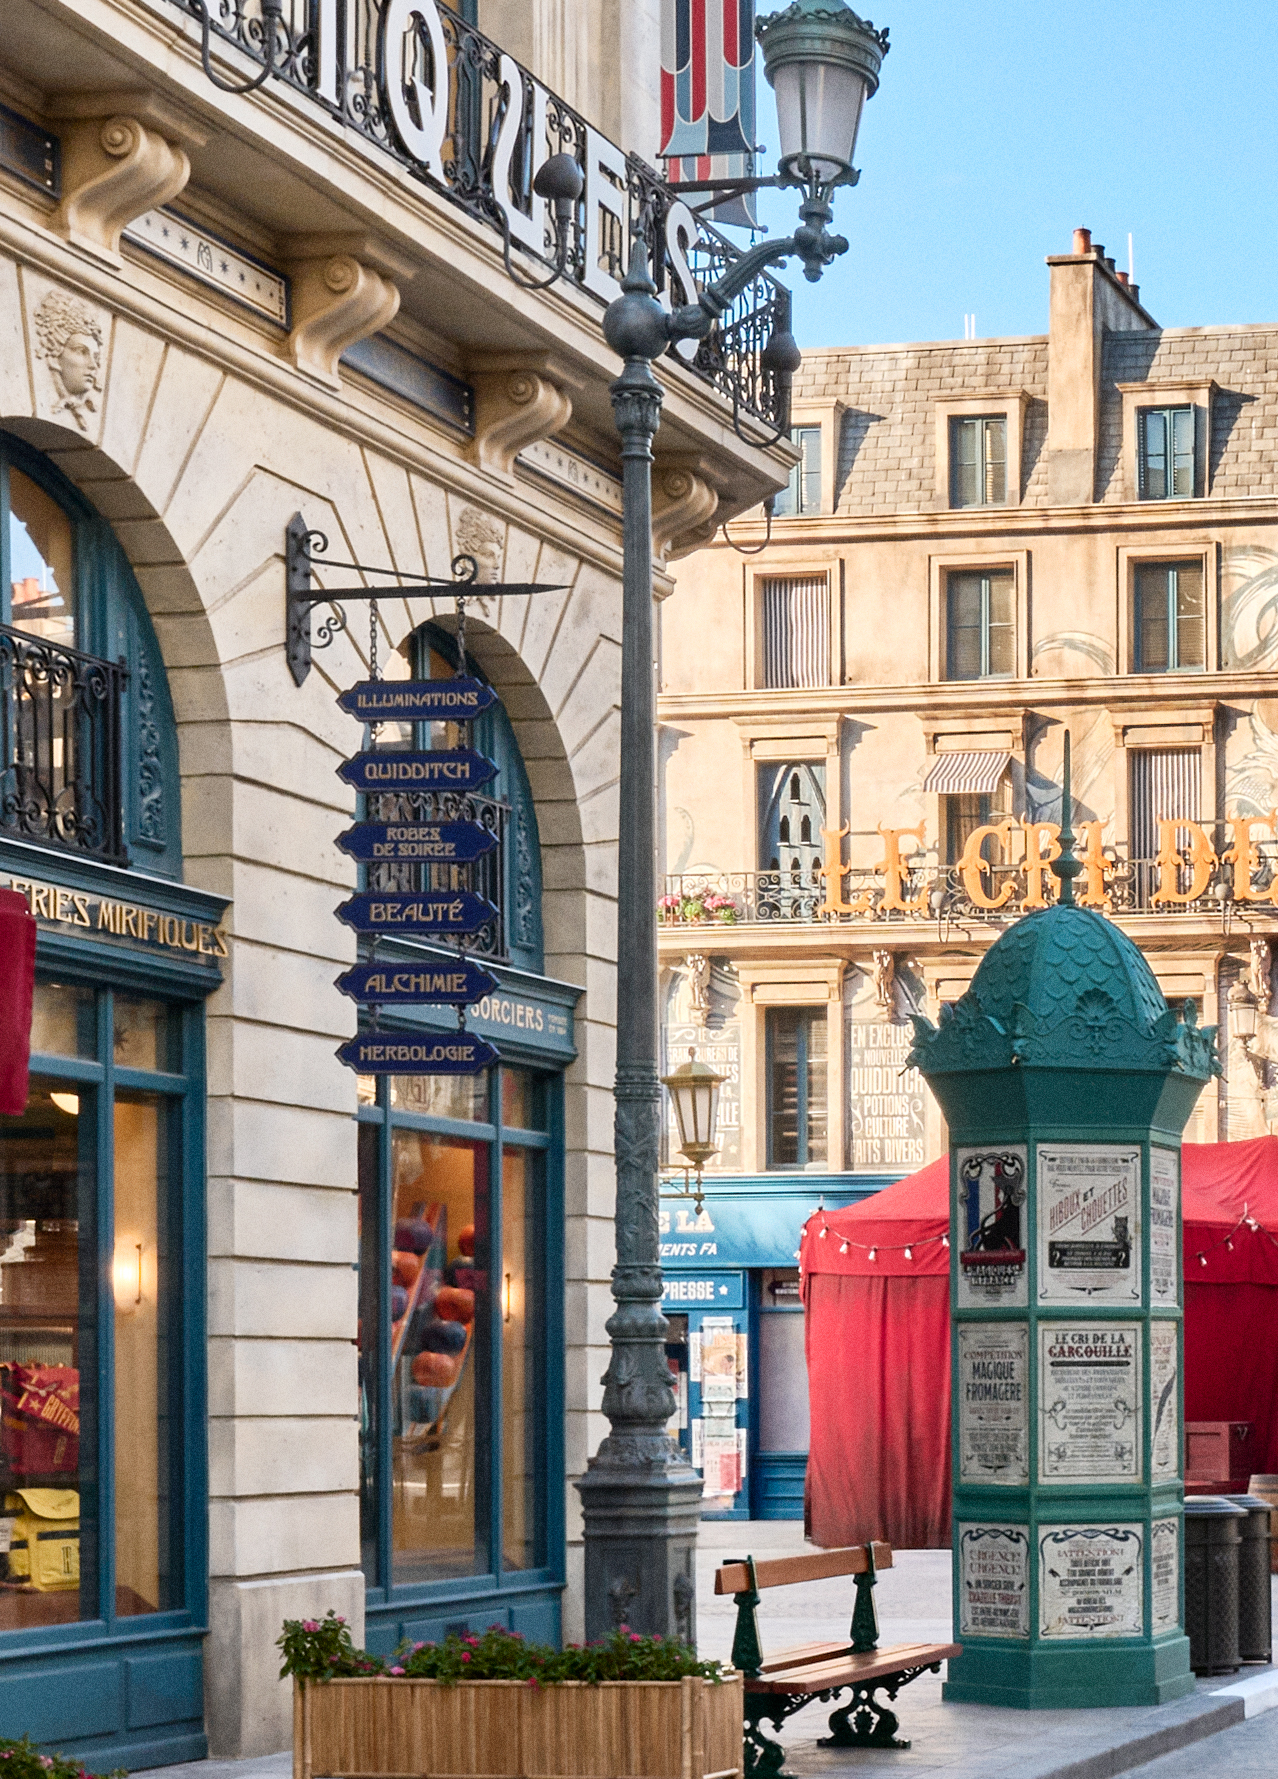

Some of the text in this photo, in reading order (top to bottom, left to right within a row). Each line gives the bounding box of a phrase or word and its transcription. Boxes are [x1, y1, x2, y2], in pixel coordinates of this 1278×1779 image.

[357, 691, 479, 708] ILLUMINATIONS
[364, 762, 471, 780] QUIDDITCH
[386, 827, 441, 841] ROBES
[372, 844, 394, 857] DE
[817, 817, 931, 919] LE
[955, 811, 1113, 915] CRI
[369, 899, 464, 922] BEAUTÉ
[97, 900, 230, 958] MIRIFIQUES
[364, 973, 468, 993] ALCHIMIE
[470, 996, 544, 1032] SORCIERS
[359, 1045, 475, 1062] HERBOLOGIE
[851, 1066, 925, 1099] QUIDDITCH
[863, 1095, 909, 1117] POTIONS
[865, 1117, 909, 1136] CULTURE
[851, 1139, 924, 1163] FAITS DIVERS
[675, 1209, 715, 1233] LA
[661, 1281, 715, 1300] PRESSE
[1054, 1333, 1125, 1345] LE CRI DE LA
[1048, 1344, 1133, 1359] GARGOUILLE
[972, 1361, 1015, 1380] MAGIQUE
